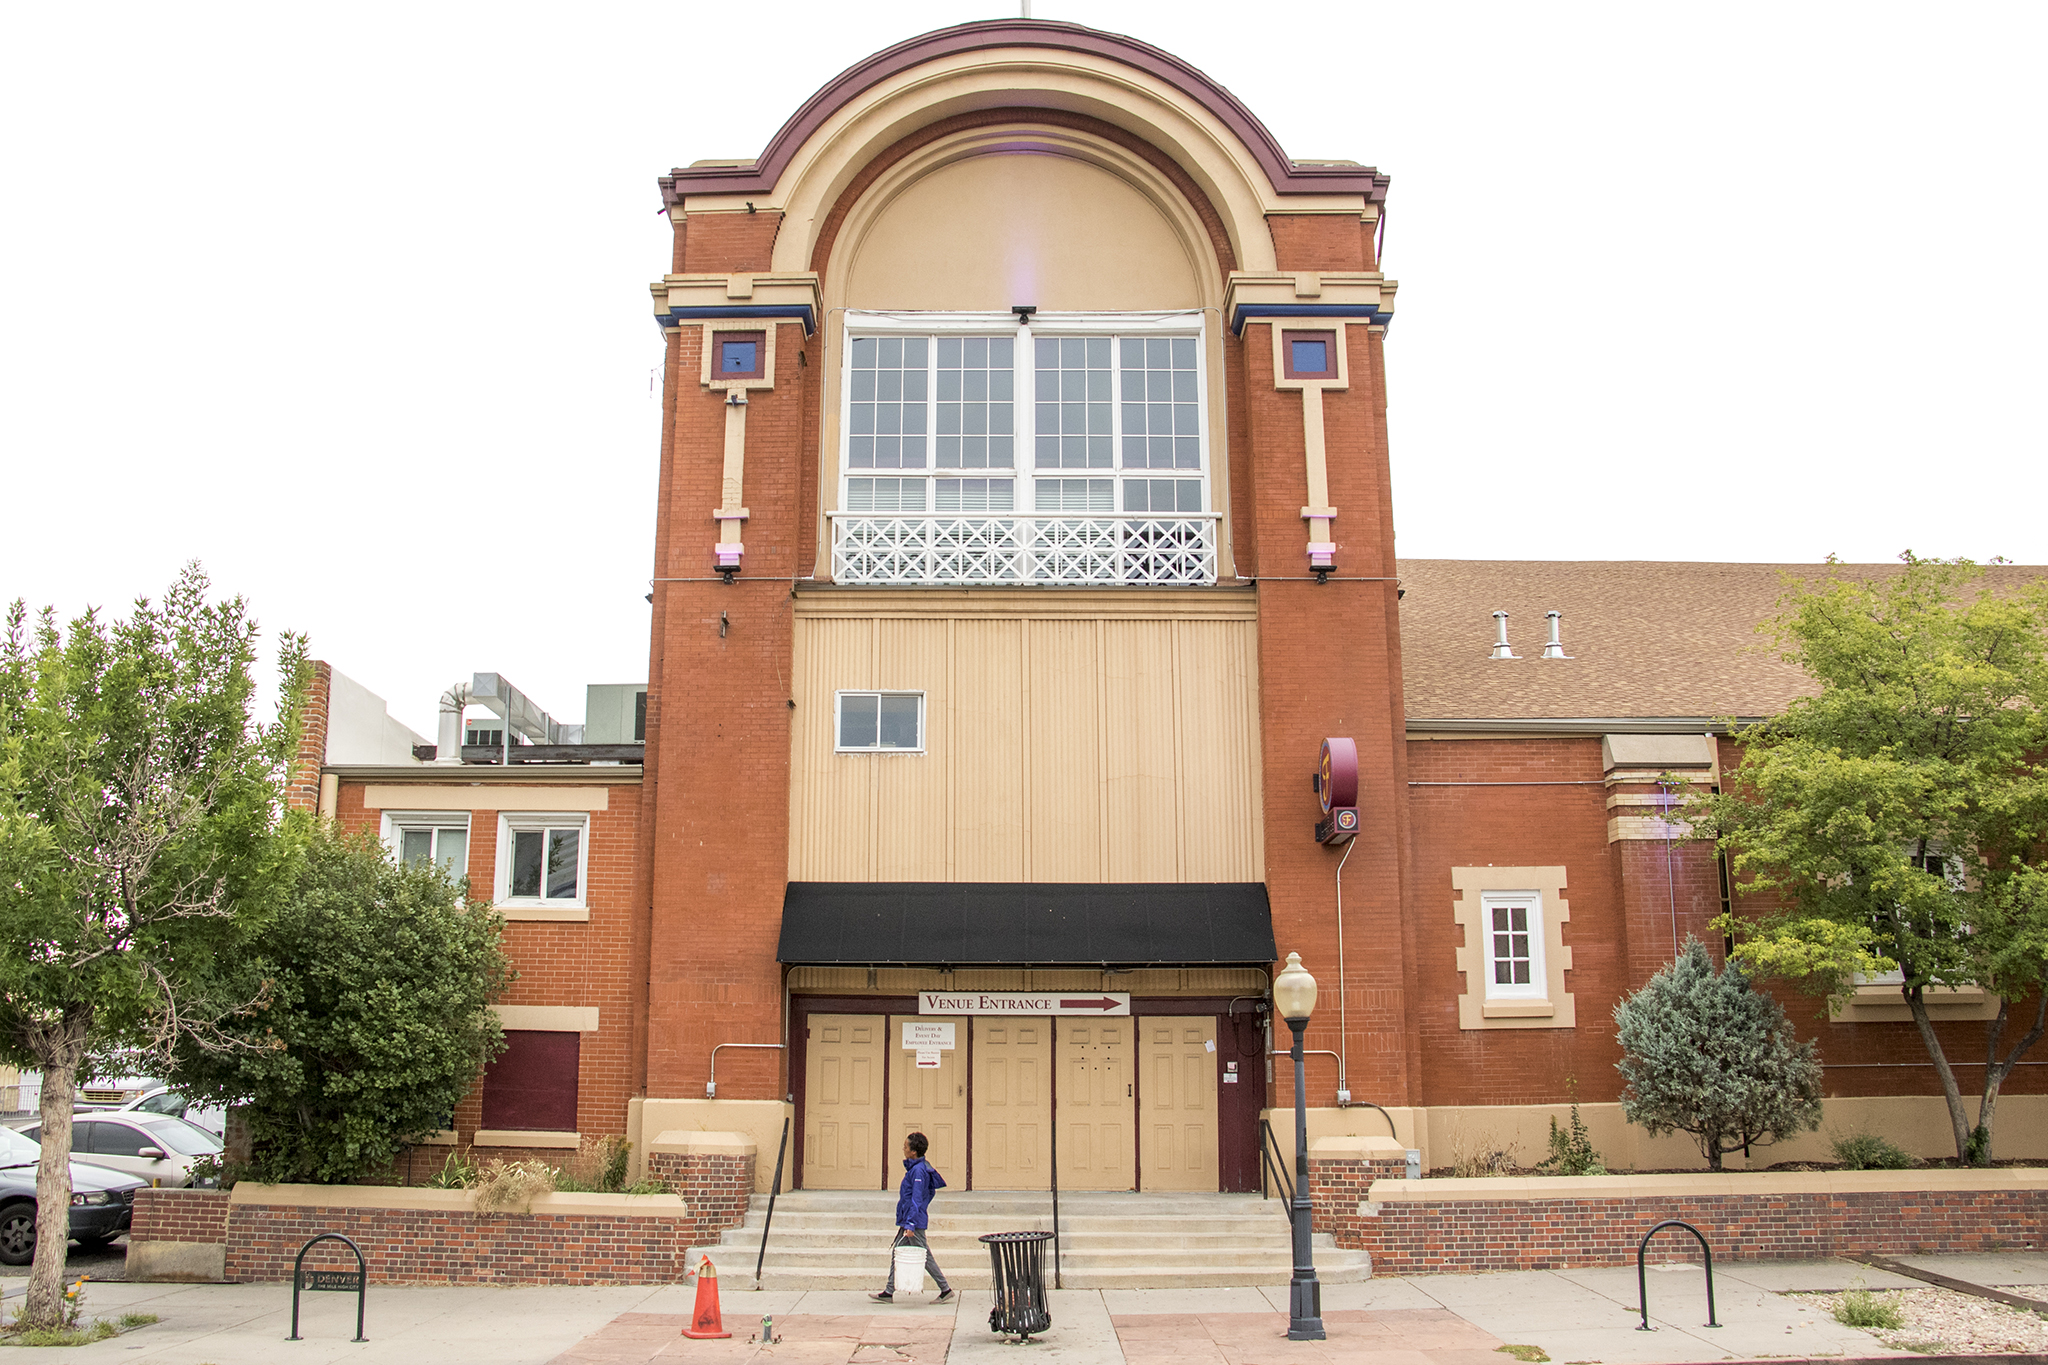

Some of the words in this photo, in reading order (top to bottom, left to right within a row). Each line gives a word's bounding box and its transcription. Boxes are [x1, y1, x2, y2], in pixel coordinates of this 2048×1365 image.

[1341, 814, 1352, 826] F
[925, 995, 974, 1009] VENUE
[978, 995, 1052, 1010] ENTRANCE
[317, 1274, 360, 1284] DENVER
